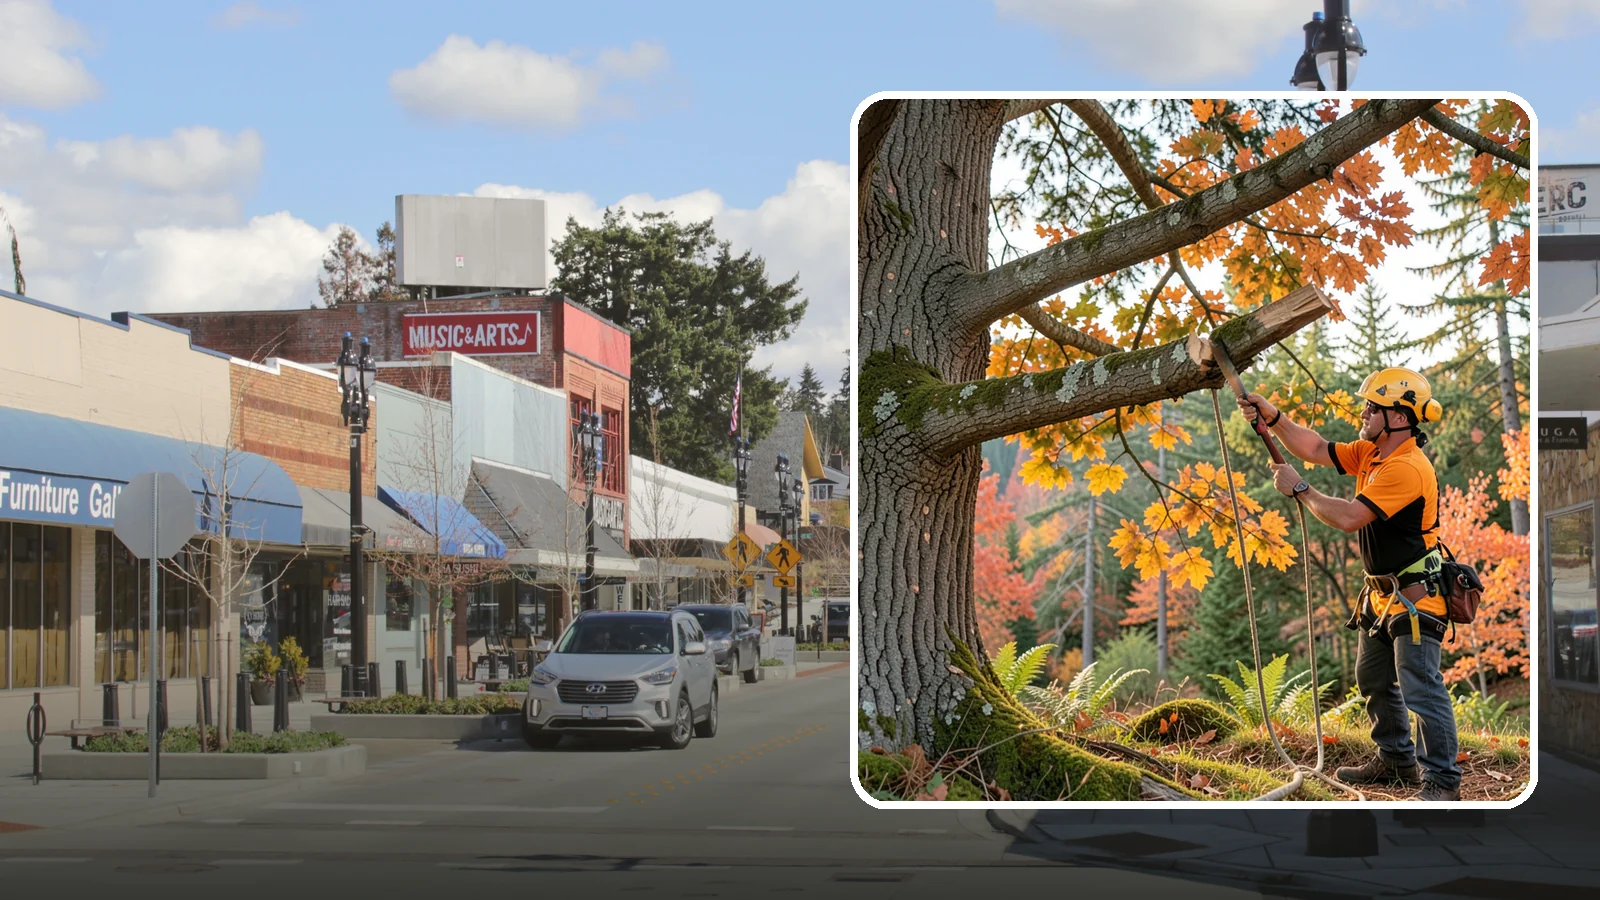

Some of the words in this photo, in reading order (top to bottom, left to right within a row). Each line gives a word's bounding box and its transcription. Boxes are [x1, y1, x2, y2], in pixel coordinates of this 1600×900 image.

[408, 322, 520, 349] MUSIC&ARTS
[0, 471, 79, 515] Furniture
[89, 482, 122, 519] Gal
